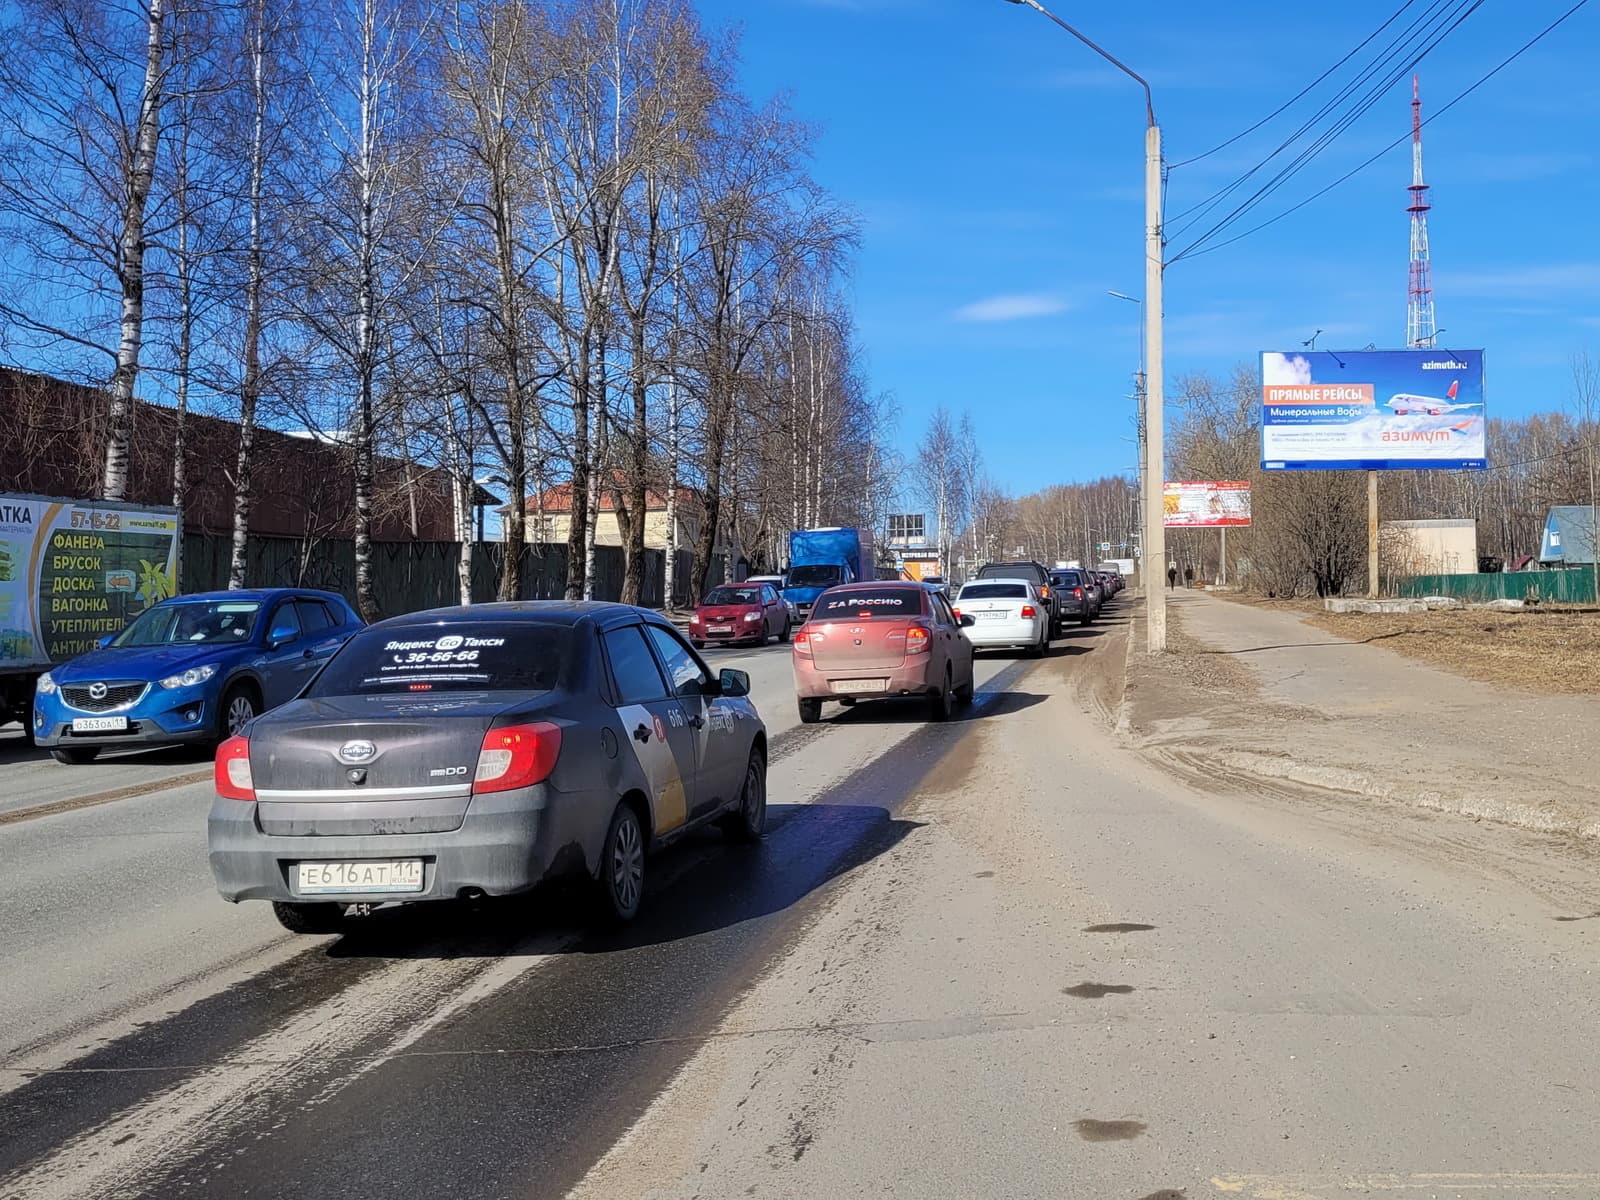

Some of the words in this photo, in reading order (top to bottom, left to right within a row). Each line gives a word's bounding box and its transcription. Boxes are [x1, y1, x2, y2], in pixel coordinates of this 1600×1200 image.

[1422, 360, 1467, 370] azimuth.ru
[1270, 389, 1321, 401] ПРЯМЫЕ
[1323, 387, 1362, 400] РЕЙСЫ
[1270, 408, 1335, 418] Минеральные
[1337, 407, 1361, 417] Воды
[54, 534, 105, 550] ФАНЕРА
[53, 556, 101, 570] БРУСОК
[52, 577, 96, 593] ДОСКА
[52, 598, 109, 613] ВАГОНКА
[384, 640, 435, 651] Яндекс
[464, 637, 505, 647] Такси
[405, 650, 480, 663] 36-66-66
[307, 863, 387, 885] Е616АТ
[395, 861, 413, 877] 11
